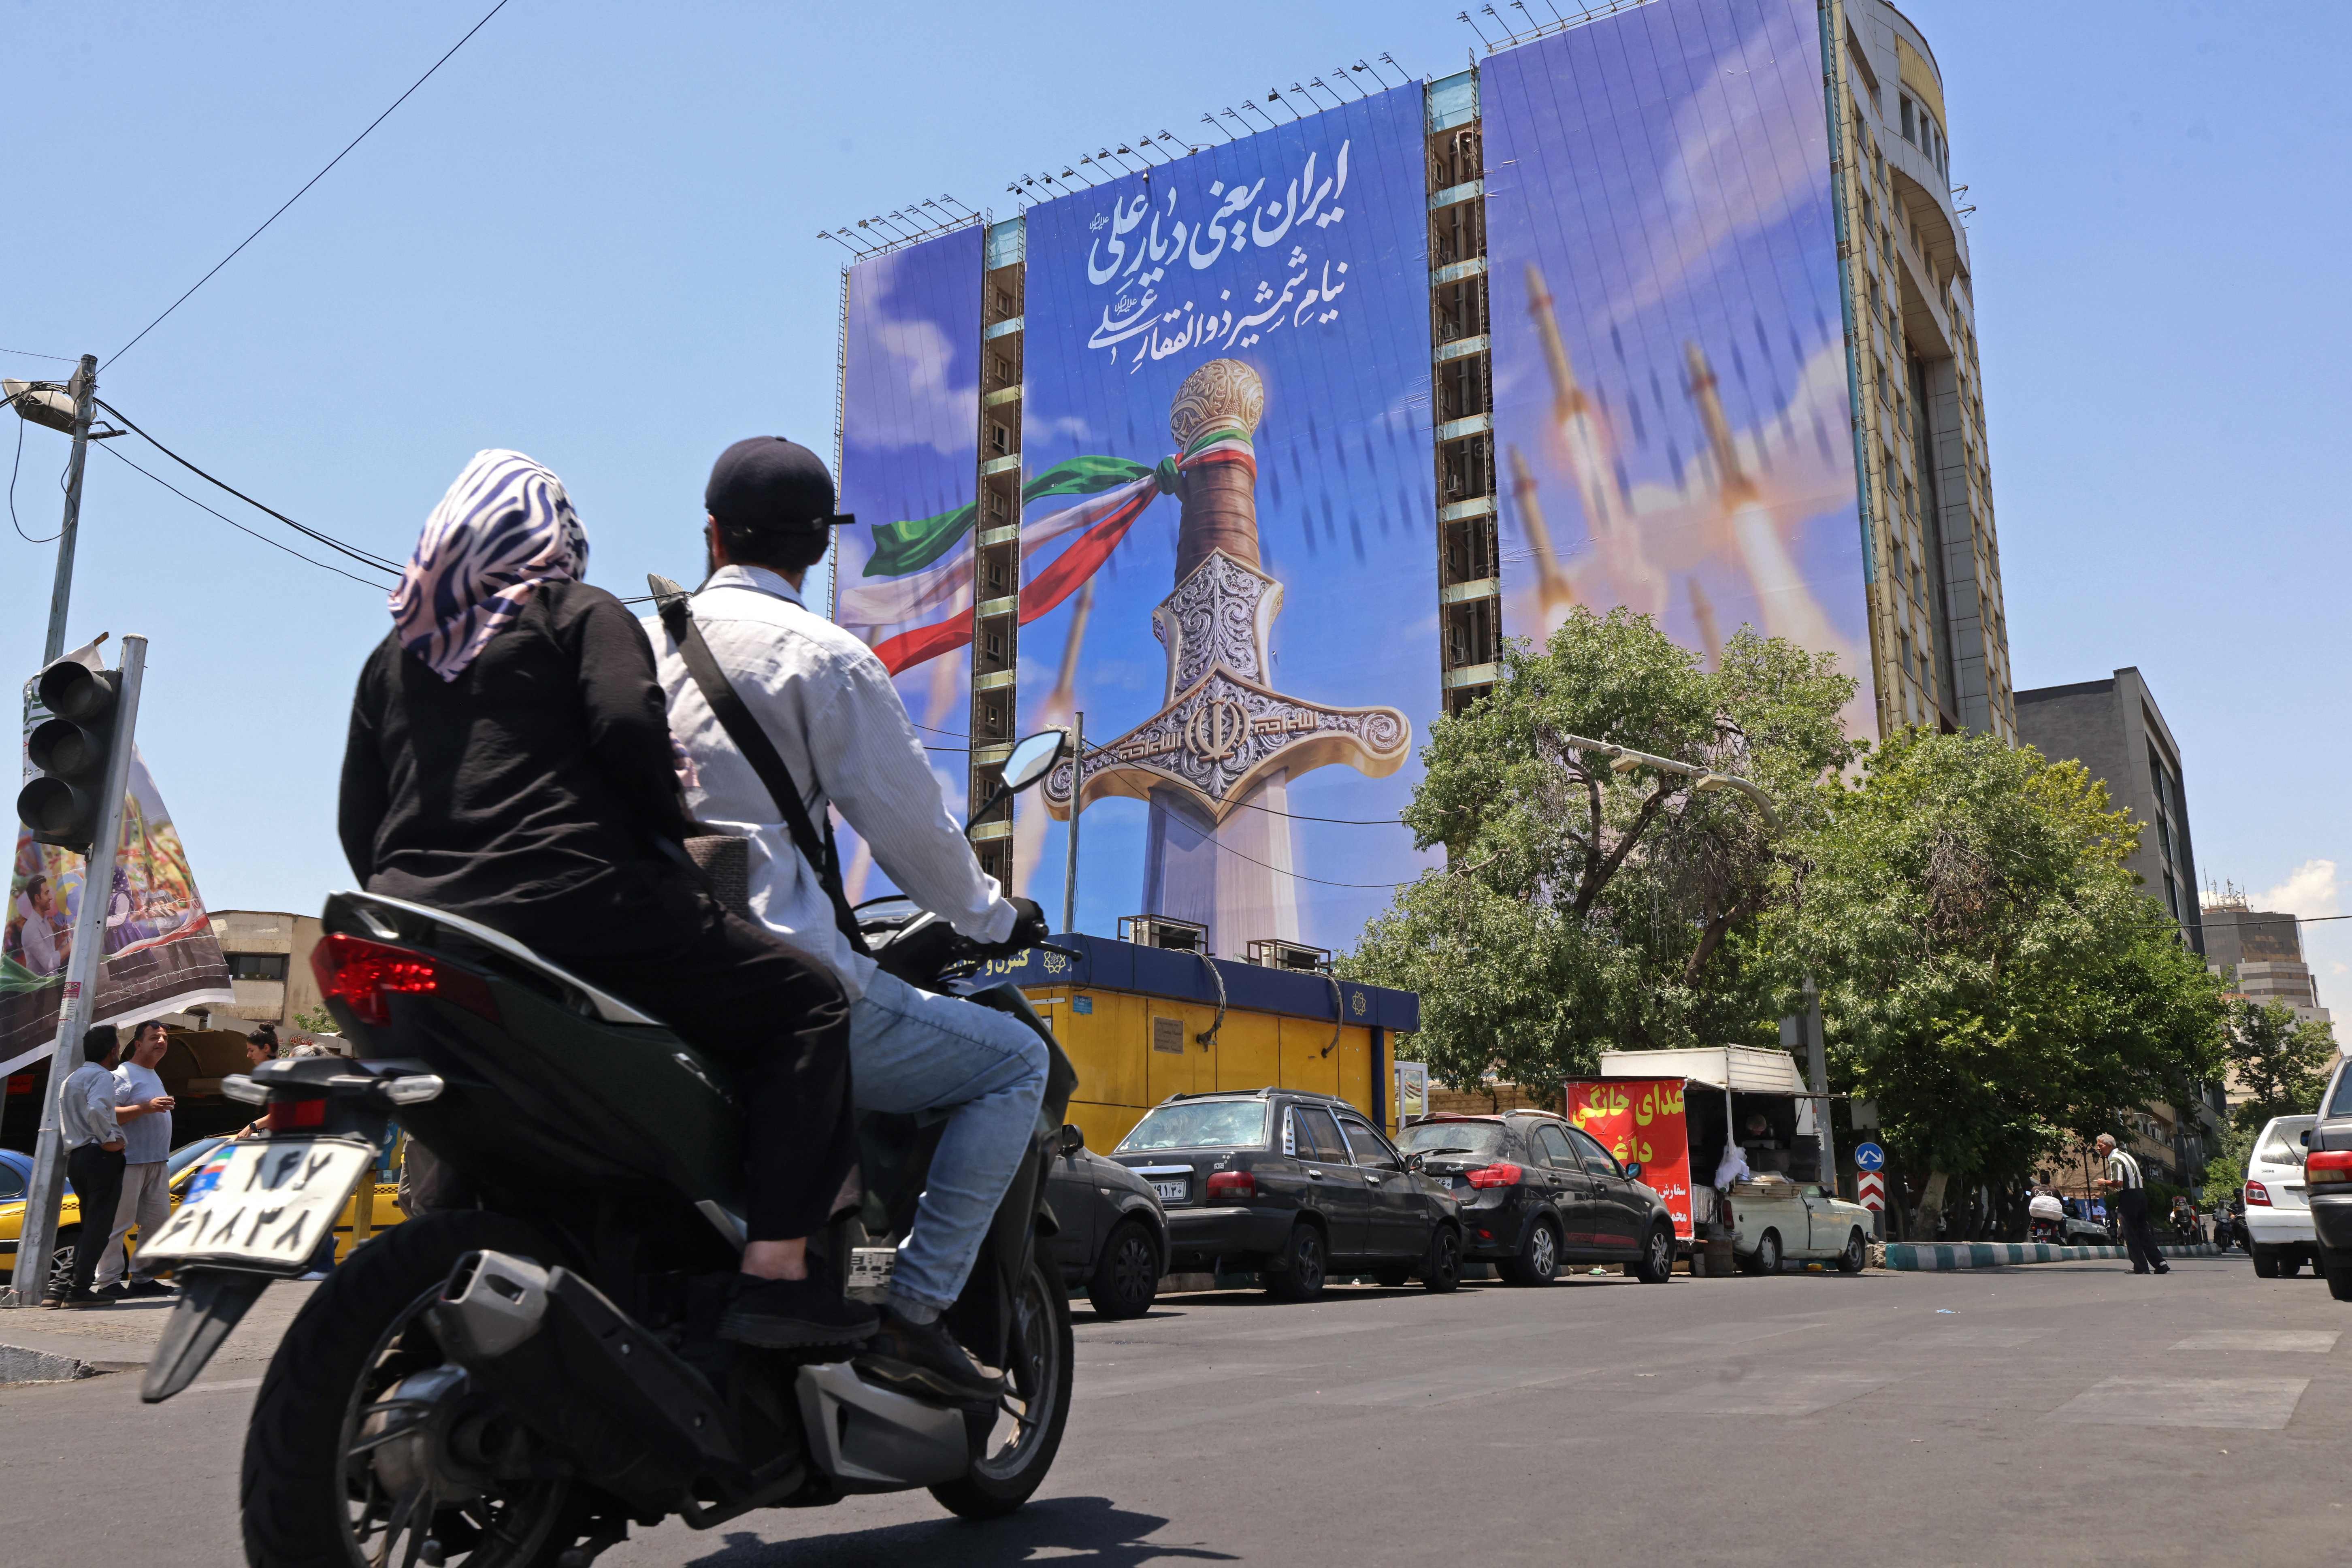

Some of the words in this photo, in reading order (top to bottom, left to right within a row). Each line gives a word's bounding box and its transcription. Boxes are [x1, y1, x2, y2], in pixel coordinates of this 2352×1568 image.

[1252, 139, 1350, 247] ایران
[1088, 195, 1148, 285] علی
[1189, 177, 1265, 270] یعنی
[1573, 1084, 1630, 1130] خانگی
[1636, 1082, 1684, 1126] غذای
[1171, 1186, 1181, 1196] ۳۰
[1659, 1184, 1686, 1199] سفارش
